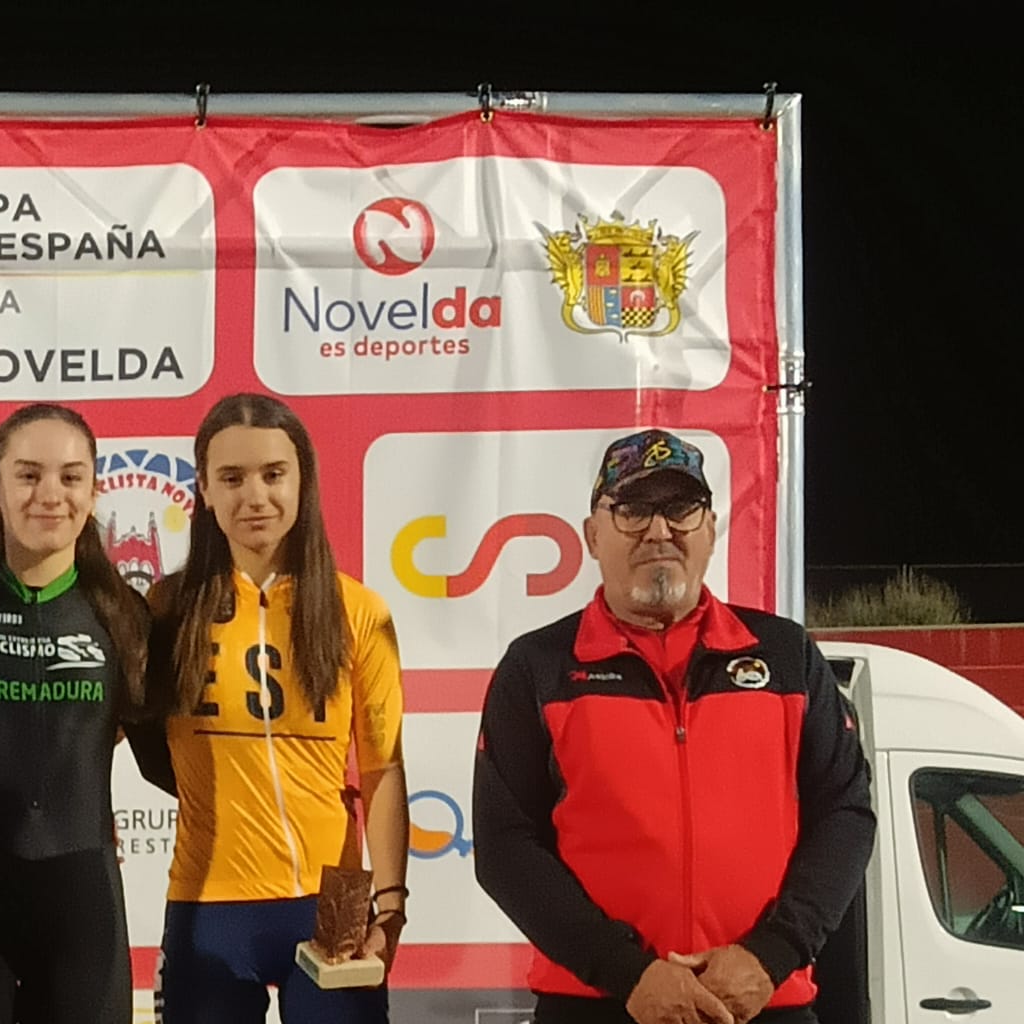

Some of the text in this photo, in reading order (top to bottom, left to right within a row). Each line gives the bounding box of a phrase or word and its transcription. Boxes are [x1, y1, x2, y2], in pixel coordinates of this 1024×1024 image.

[282, 282, 502, 333] Novelda
[319, 335, 471, 361] es deportes
[114, 808, 179, 831] GRUP
[119, 837, 171, 855] REST
